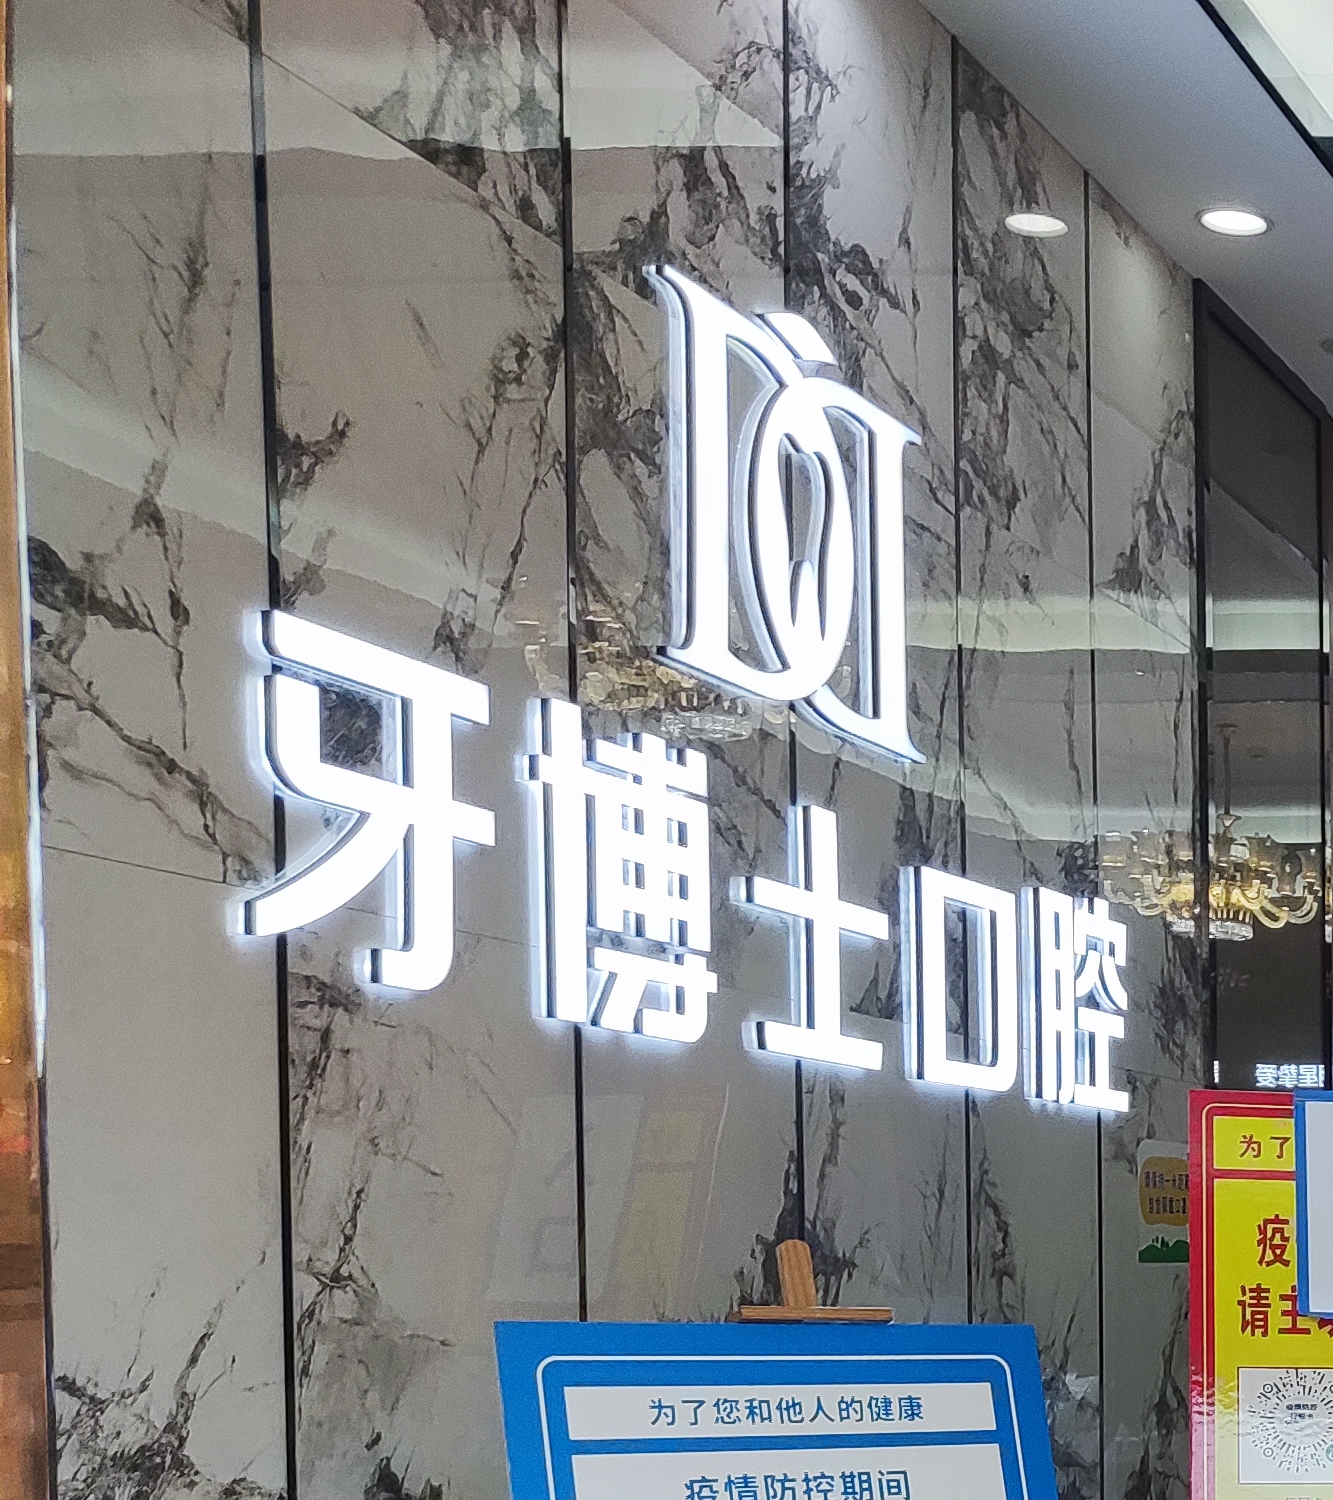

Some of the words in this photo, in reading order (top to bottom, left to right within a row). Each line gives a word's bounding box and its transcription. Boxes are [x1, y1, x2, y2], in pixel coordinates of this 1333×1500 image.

[230, 608, 1130, 1112] 牙博士口腔
[649, 1395, 925, 1428] 为了您和他人的健康
